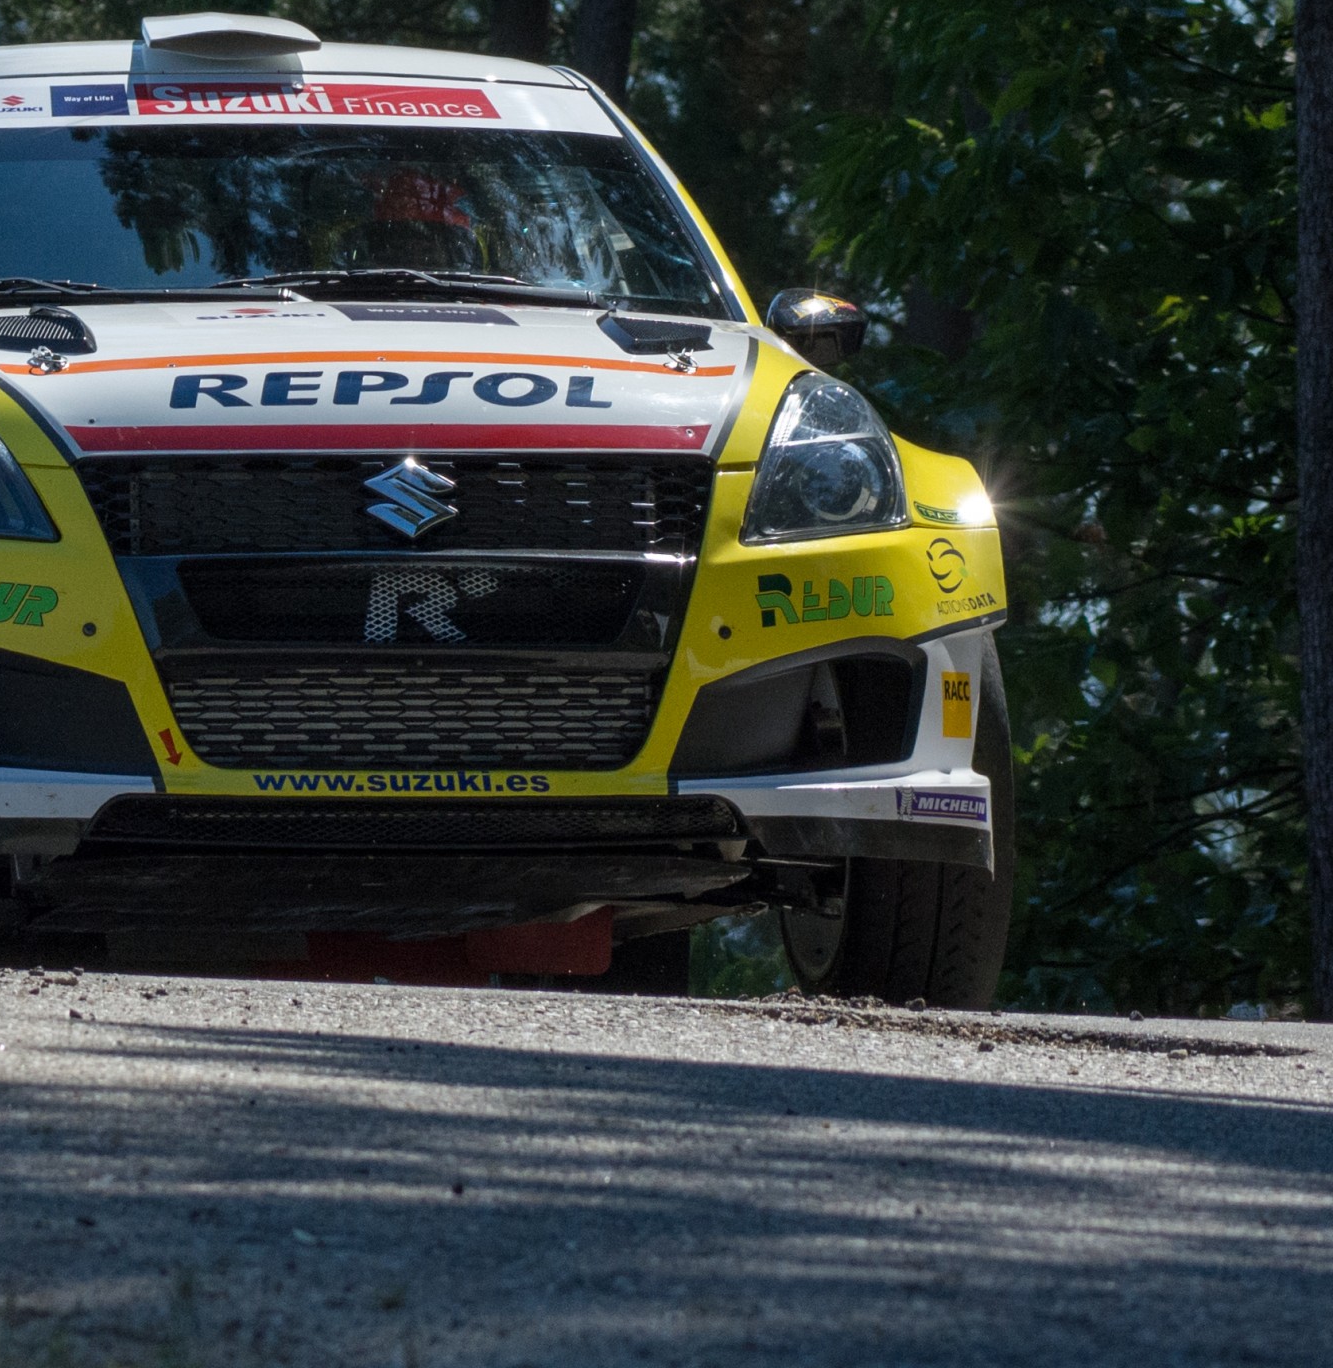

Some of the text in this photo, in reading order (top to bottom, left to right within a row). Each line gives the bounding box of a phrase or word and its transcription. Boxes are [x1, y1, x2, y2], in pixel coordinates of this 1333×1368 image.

[64, 95, 83, 104] Way
[153, 85, 483, 117] Suzuki Finance
[196, 312, 326, 320] SUZUKI
[169, 370, 613, 409] REPSOL
[755, 573, 895, 628] REDUR
[936, 591, 997, 615] ACTIONSDATA
[944, 680, 970, 701] RACC
[253, 771, 551, 793] www.suzuki.es
[917, 796, 987, 815] MICHELIN
